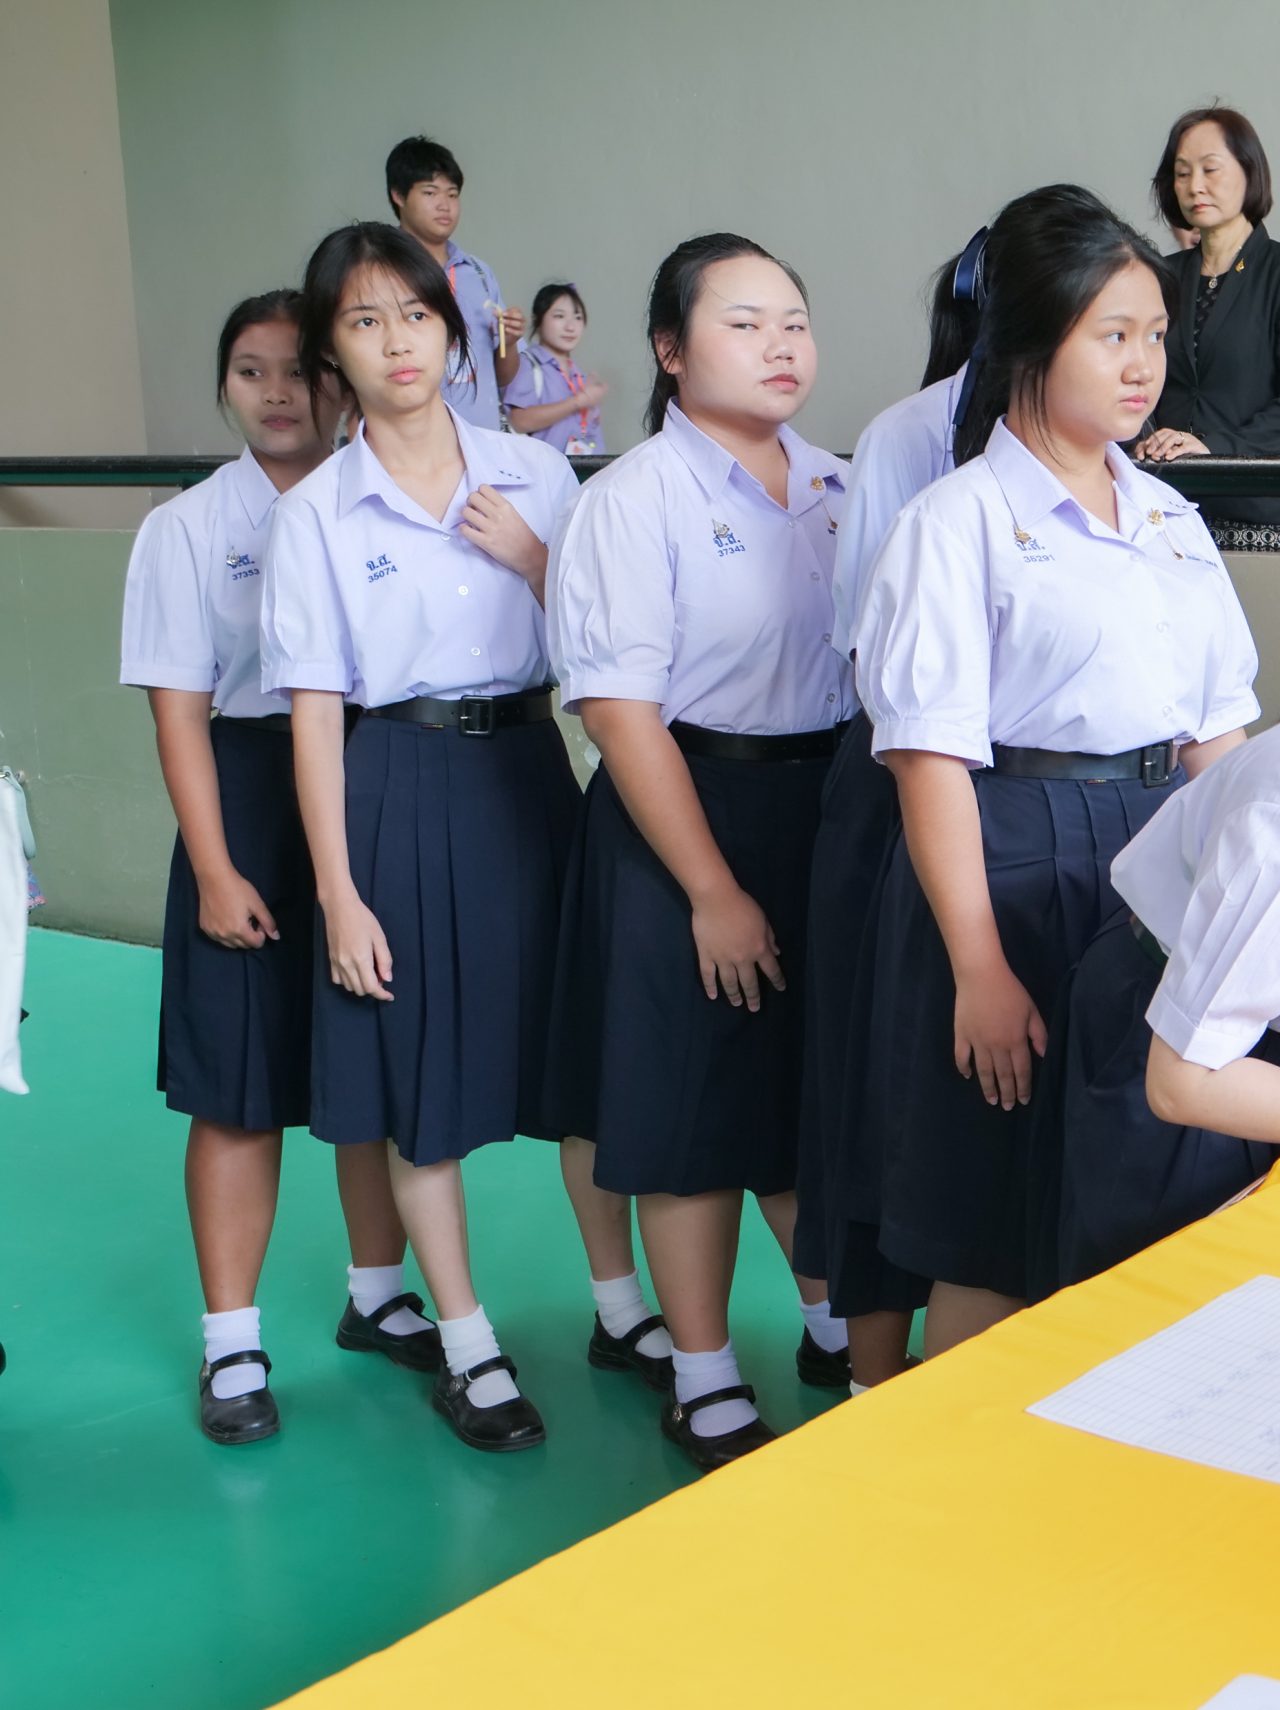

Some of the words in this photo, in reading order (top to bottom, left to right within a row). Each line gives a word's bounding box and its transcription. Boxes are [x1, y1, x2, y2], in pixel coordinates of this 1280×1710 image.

[718, 545, 746, 557] 37343
[232, 568, 260, 581] 37353
[368, 565, 398, 583] 35074
